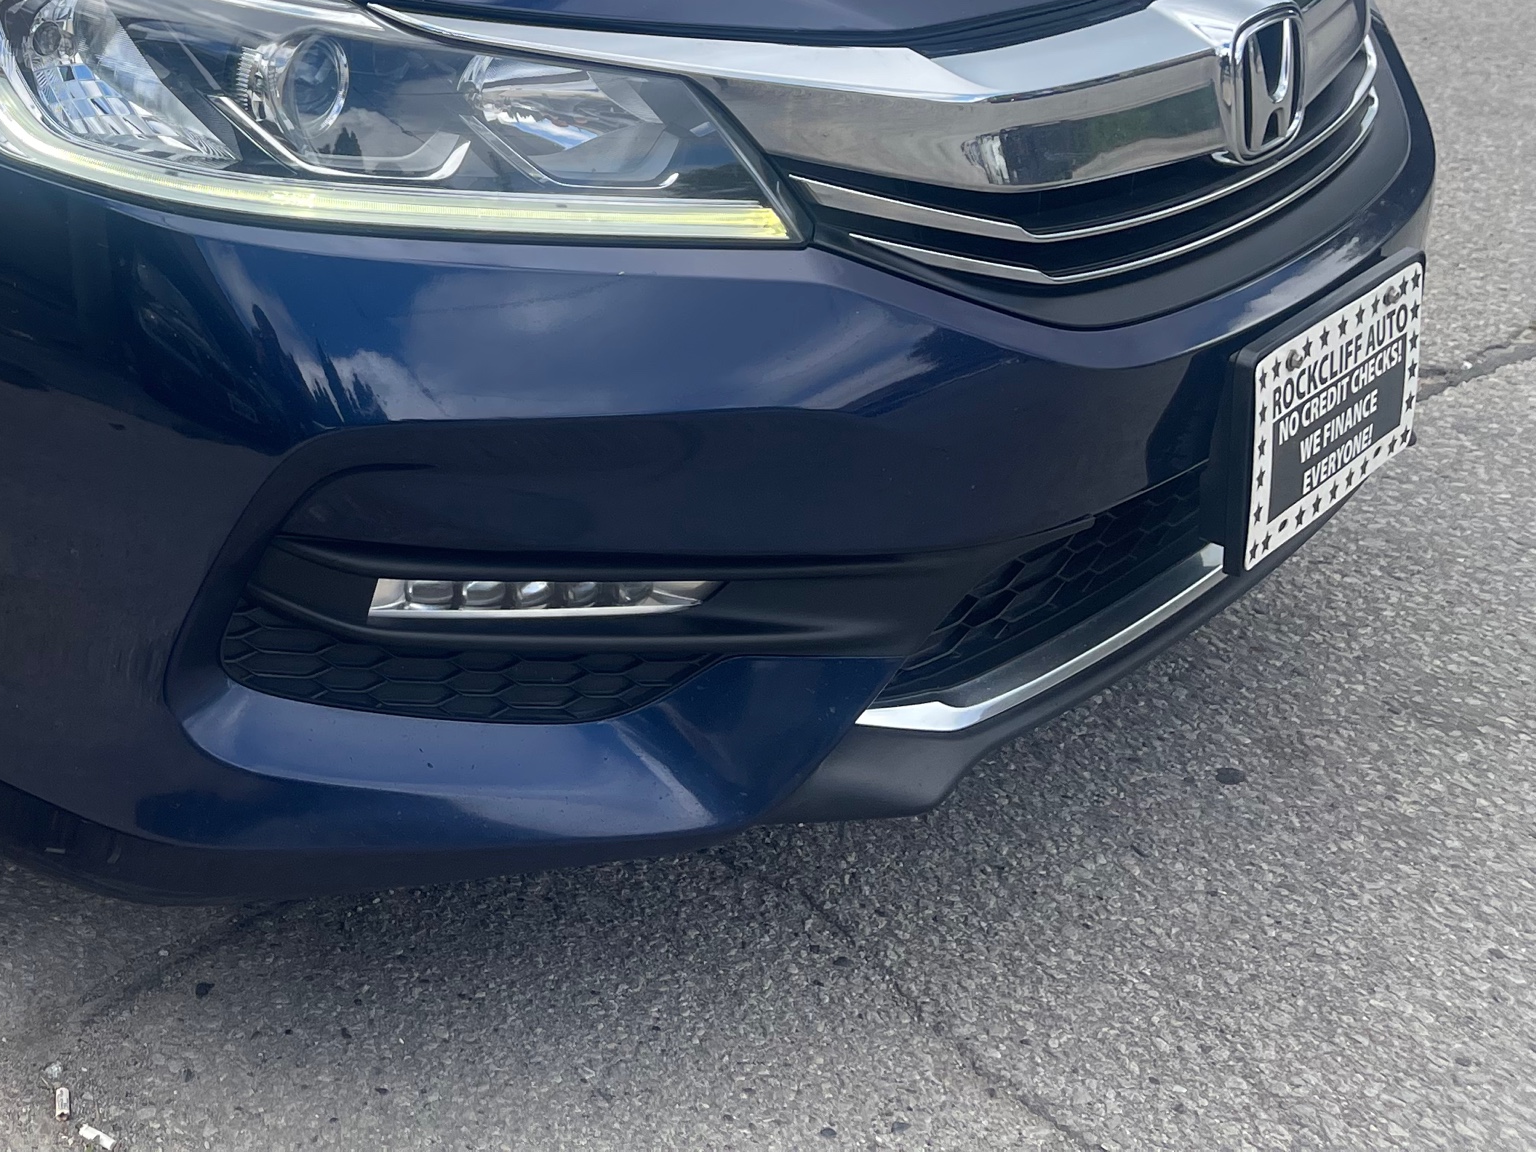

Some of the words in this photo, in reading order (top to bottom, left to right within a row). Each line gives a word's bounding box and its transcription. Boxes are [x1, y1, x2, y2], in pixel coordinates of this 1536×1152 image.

[1272, 338, 1363, 419] ROCKCLIFF
[1367, 303, 1408, 354] AUTO
[1278, 414, 1299, 446] NO
[1301, 379, 1349, 434] CREDIT
[1350, 337, 1402, 396] CHECKS!
[1299, 431, 1321, 464] WE
[1322, 389, 1378, 450] FINANCE
[1301, 423, 1374, 496] EVERYONE!
